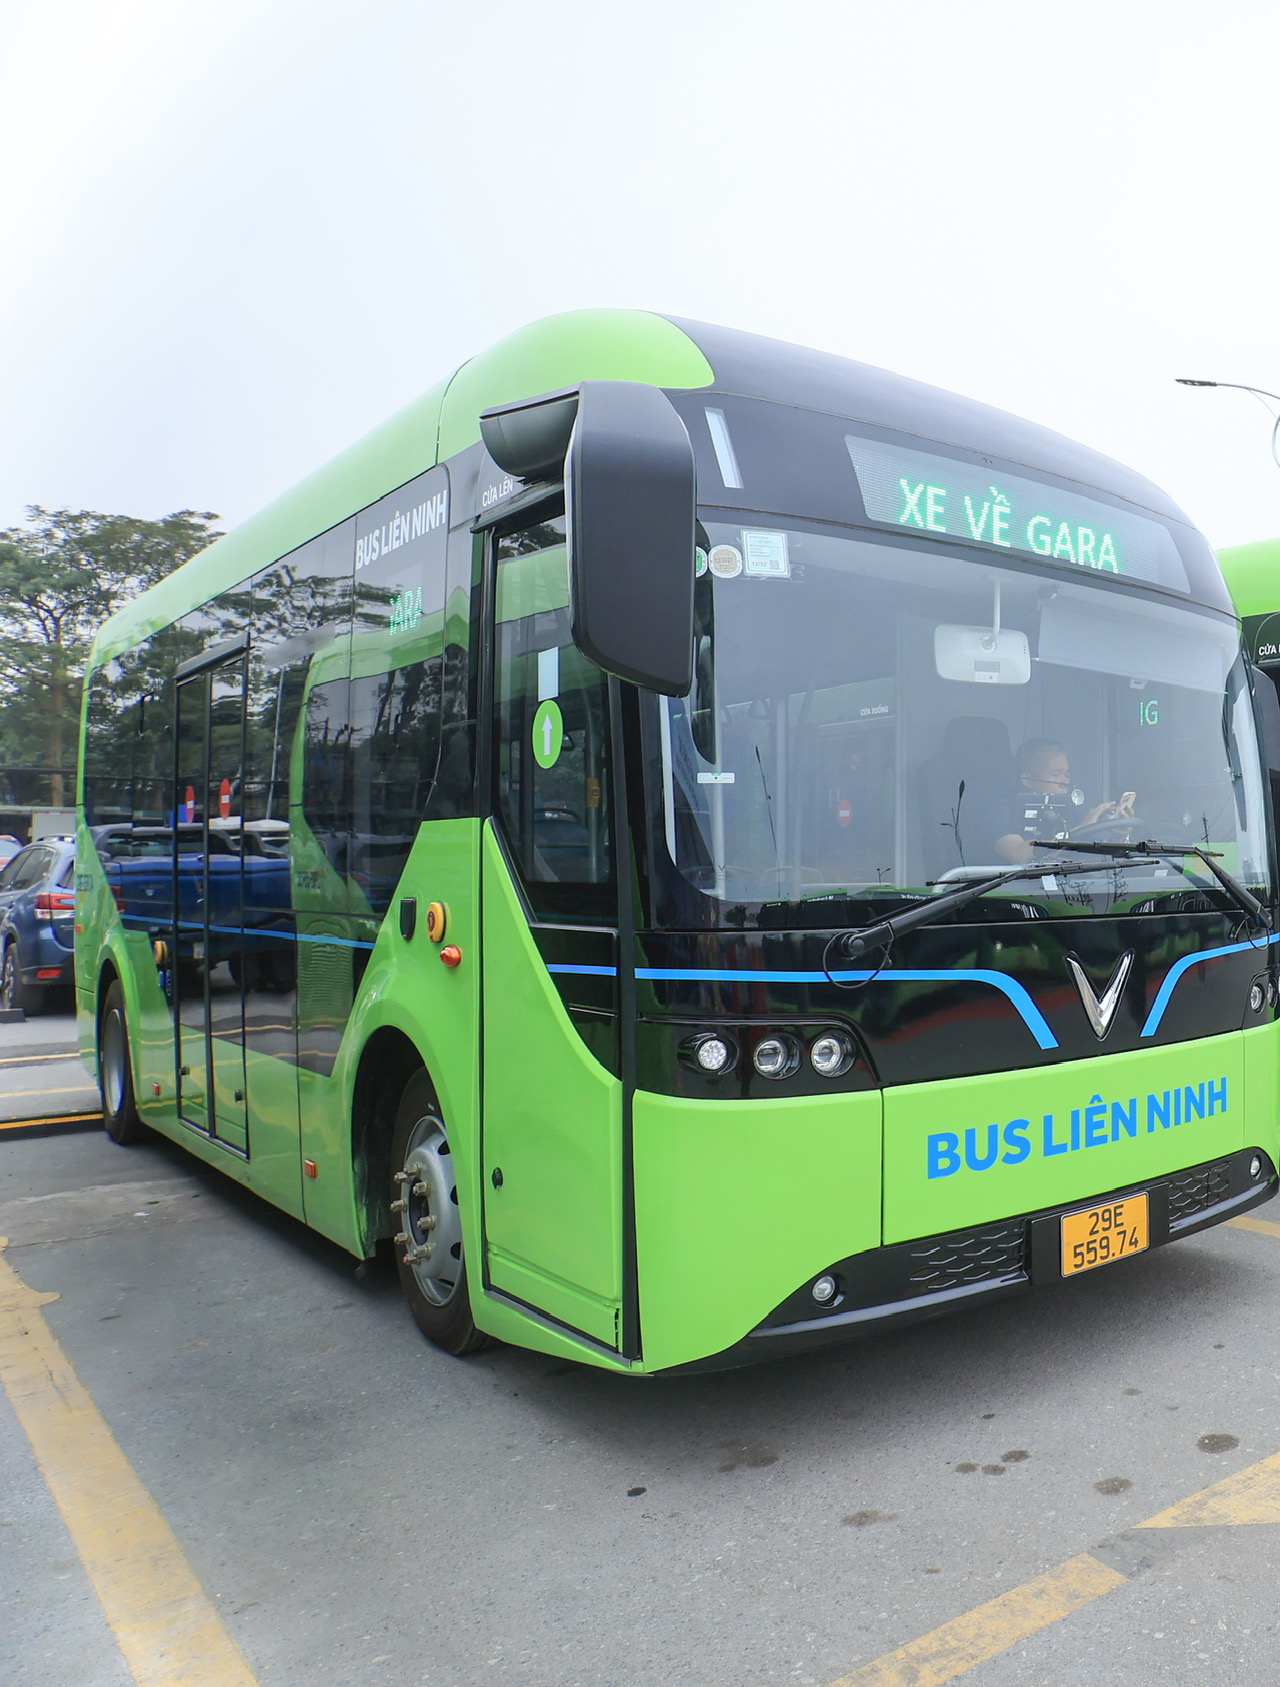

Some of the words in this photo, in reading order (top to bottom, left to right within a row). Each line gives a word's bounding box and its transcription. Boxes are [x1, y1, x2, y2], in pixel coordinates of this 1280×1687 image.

[482, 485, 498, 507] CỬA
[499, 476, 514, 498] LÊN
[355, 529, 380, 570] BUS
[381, 511, 410, 556] LIÊN
[411, 489, 447, 540] NINH
[899, 478, 946, 533] XE
[964, 486, 1011, 548] VỀ
[1027, 515, 1120, 574] GARA
[1258, 643, 1277, 656] CỬA
[927, 1118, 1032, 1180] BUS
[1043, 1093, 1138, 1158] LIÊN
[1146, 1076, 1228, 1133] NINH
[1088, 1204, 1125, 1236] 29E
[1073, 1227, 1140, 1270] 559.74
